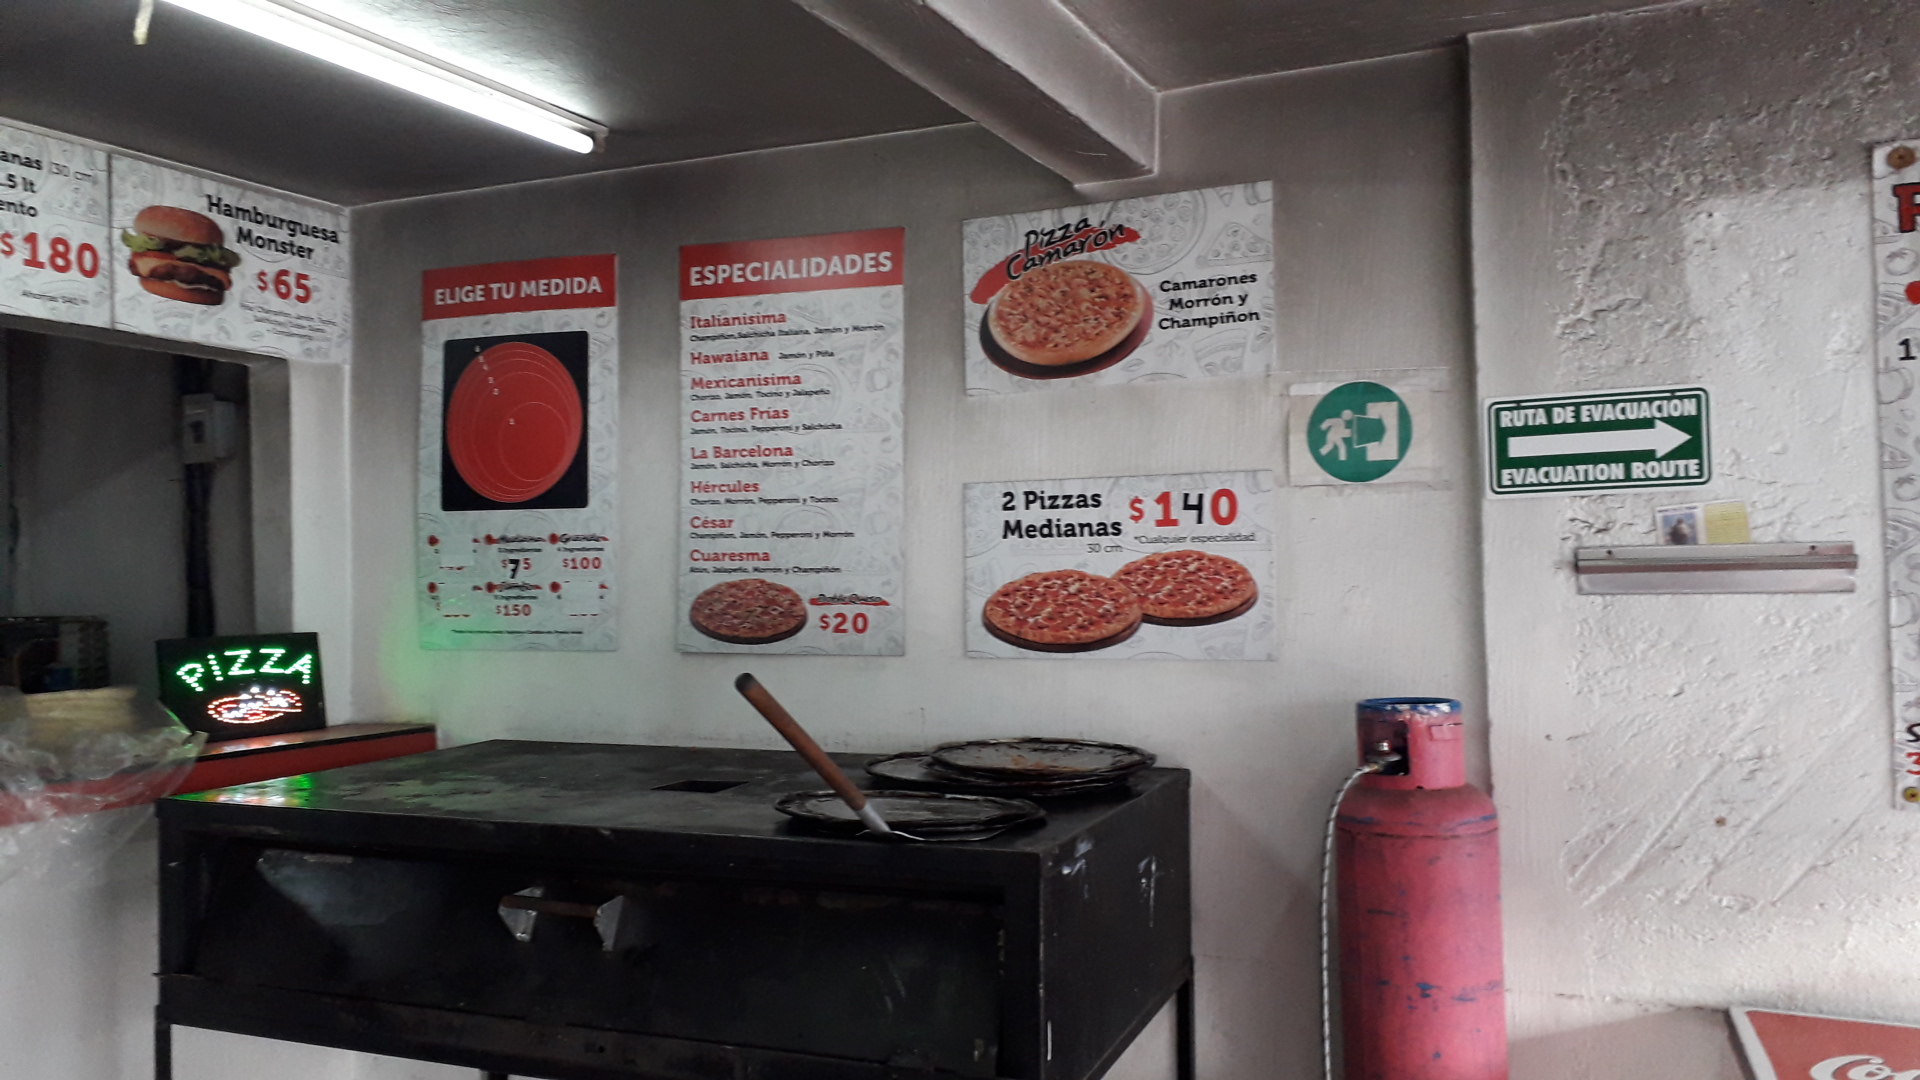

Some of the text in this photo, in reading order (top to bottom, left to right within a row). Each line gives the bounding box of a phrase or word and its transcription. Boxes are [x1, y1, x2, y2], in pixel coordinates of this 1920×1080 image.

[205, 194, 340, 244] Hamburguesa
[236, 227, 315, 260] Monster
[1024, 217, 1091, 257] Pizza
[1006, 220, 1125, 280] Camarón
[689, 251, 893, 287] ESPECIALIDADES
[257, 269, 312, 304] $65
[434, 275, 603, 305] ELIGE TU MEDIDA
[1160, 273, 1258, 293] Camarones
[1169, 293, 1249, 311] Morrón y
[690, 350, 770, 365] Hawaiana
[690, 409, 745, 422] Carnes
[1500, 408, 1549, 428] RUTA
[1552, 406, 1576, 424] DE
[690, 445, 794, 459] La Barcelona
[1501, 459, 1701, 486] EVACUATION ROUTE
[1002, 490, 1103, 511] 2 Pizzas
[1129, 488, 1239, 528] $140
[1002, 518, 1123, 540] Medianas
[690, 549, 771, 562] Cuaresma
[1087, 543, 1123, 554] 30 cm
[562, 557, 602, 570] $100
[496, 604, 532, 616] $150
[819, 612, 869, 634] $20
[176, 648, 312, 692] PIZZA
